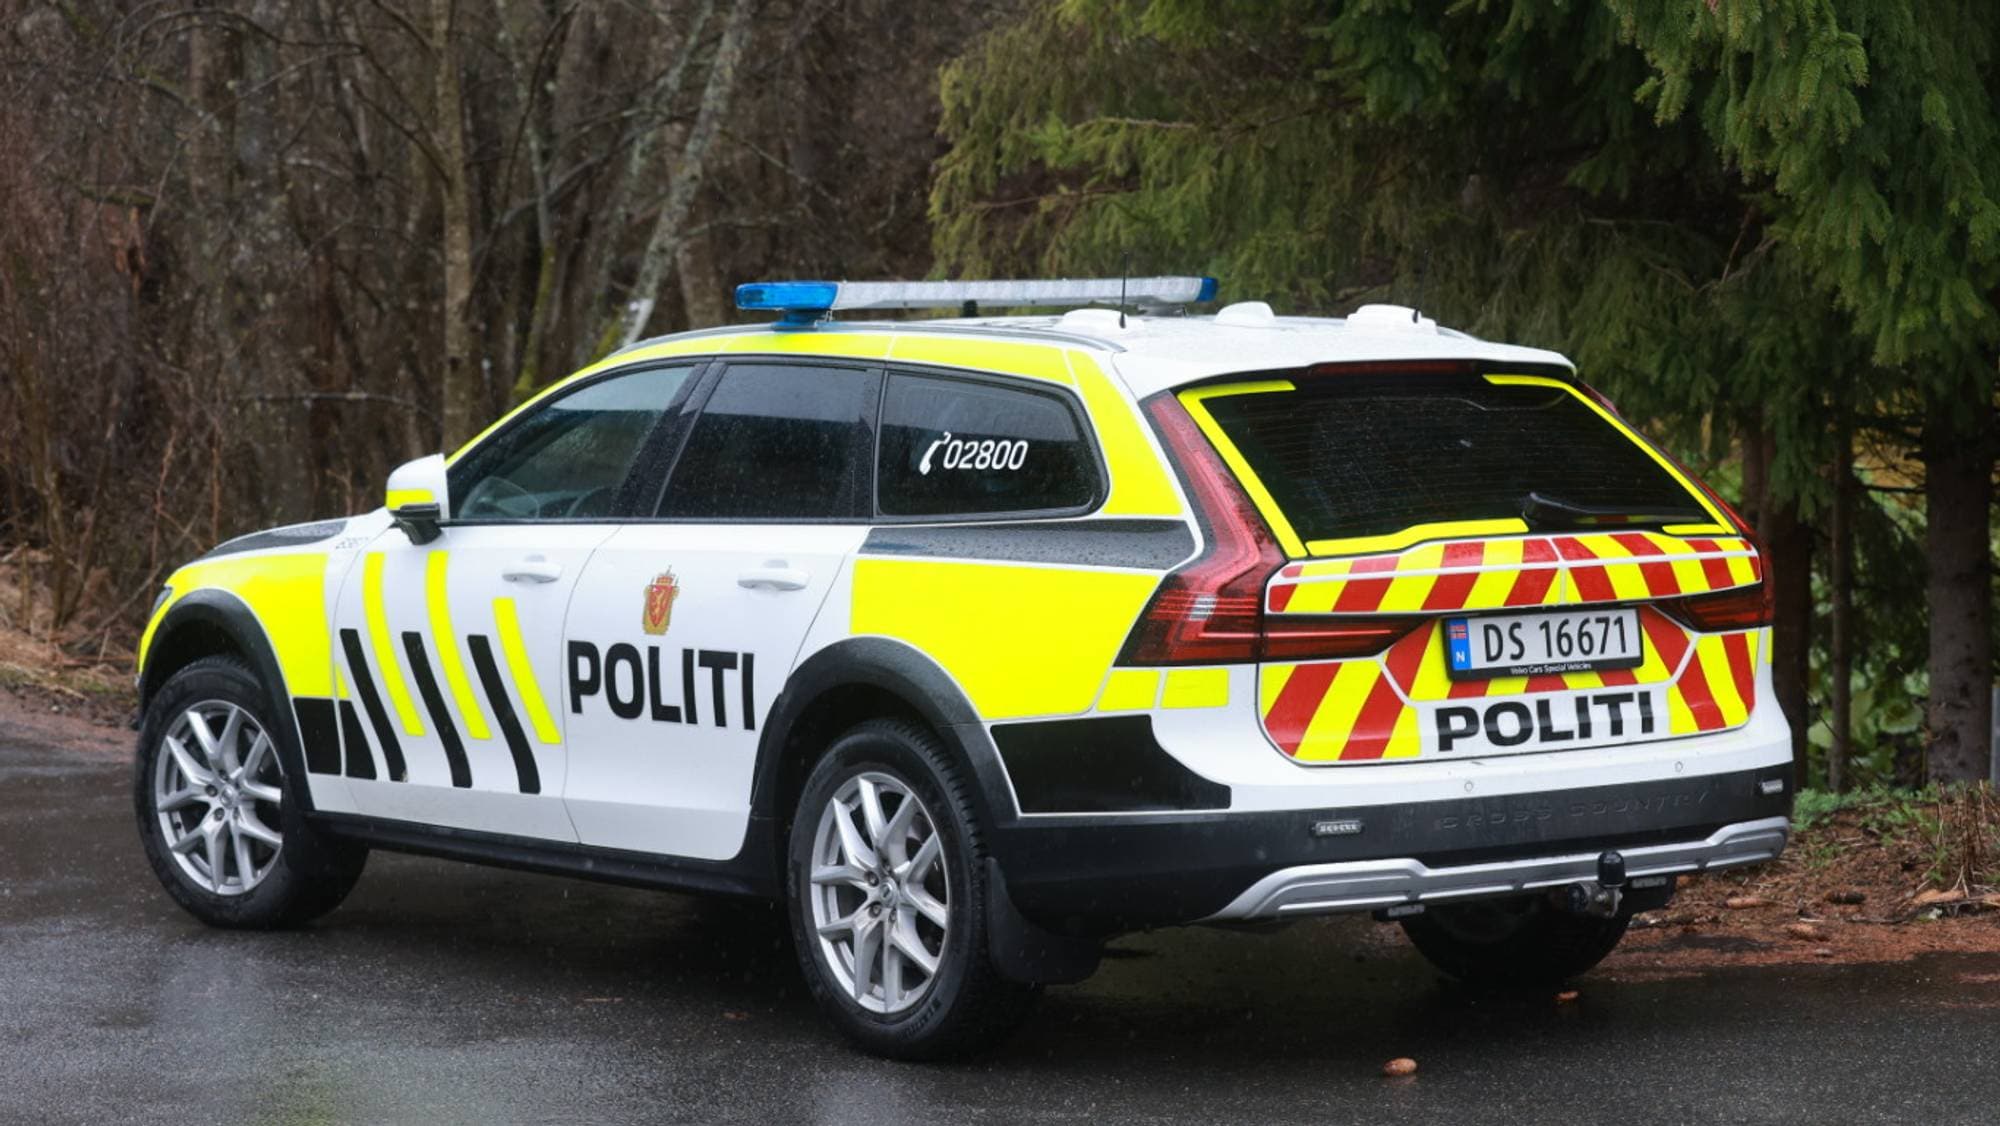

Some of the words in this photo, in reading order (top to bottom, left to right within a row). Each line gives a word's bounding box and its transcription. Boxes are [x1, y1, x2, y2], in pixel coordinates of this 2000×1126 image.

[943, 440, 1028, 470] 02800
[1455, 651, 1466, 663] N
[1482, 621, 1526, 663] DS
[1539, 615, 1627, 659] 16671
[567, 640, 756, 731] POLITI
[1510, 666, 1528, 675] Volvo
[1529, 665, 1543, 674] Cars
[1544, 663, 1566, 674] Special
[1436, 690, 1655, 753] POLITI
